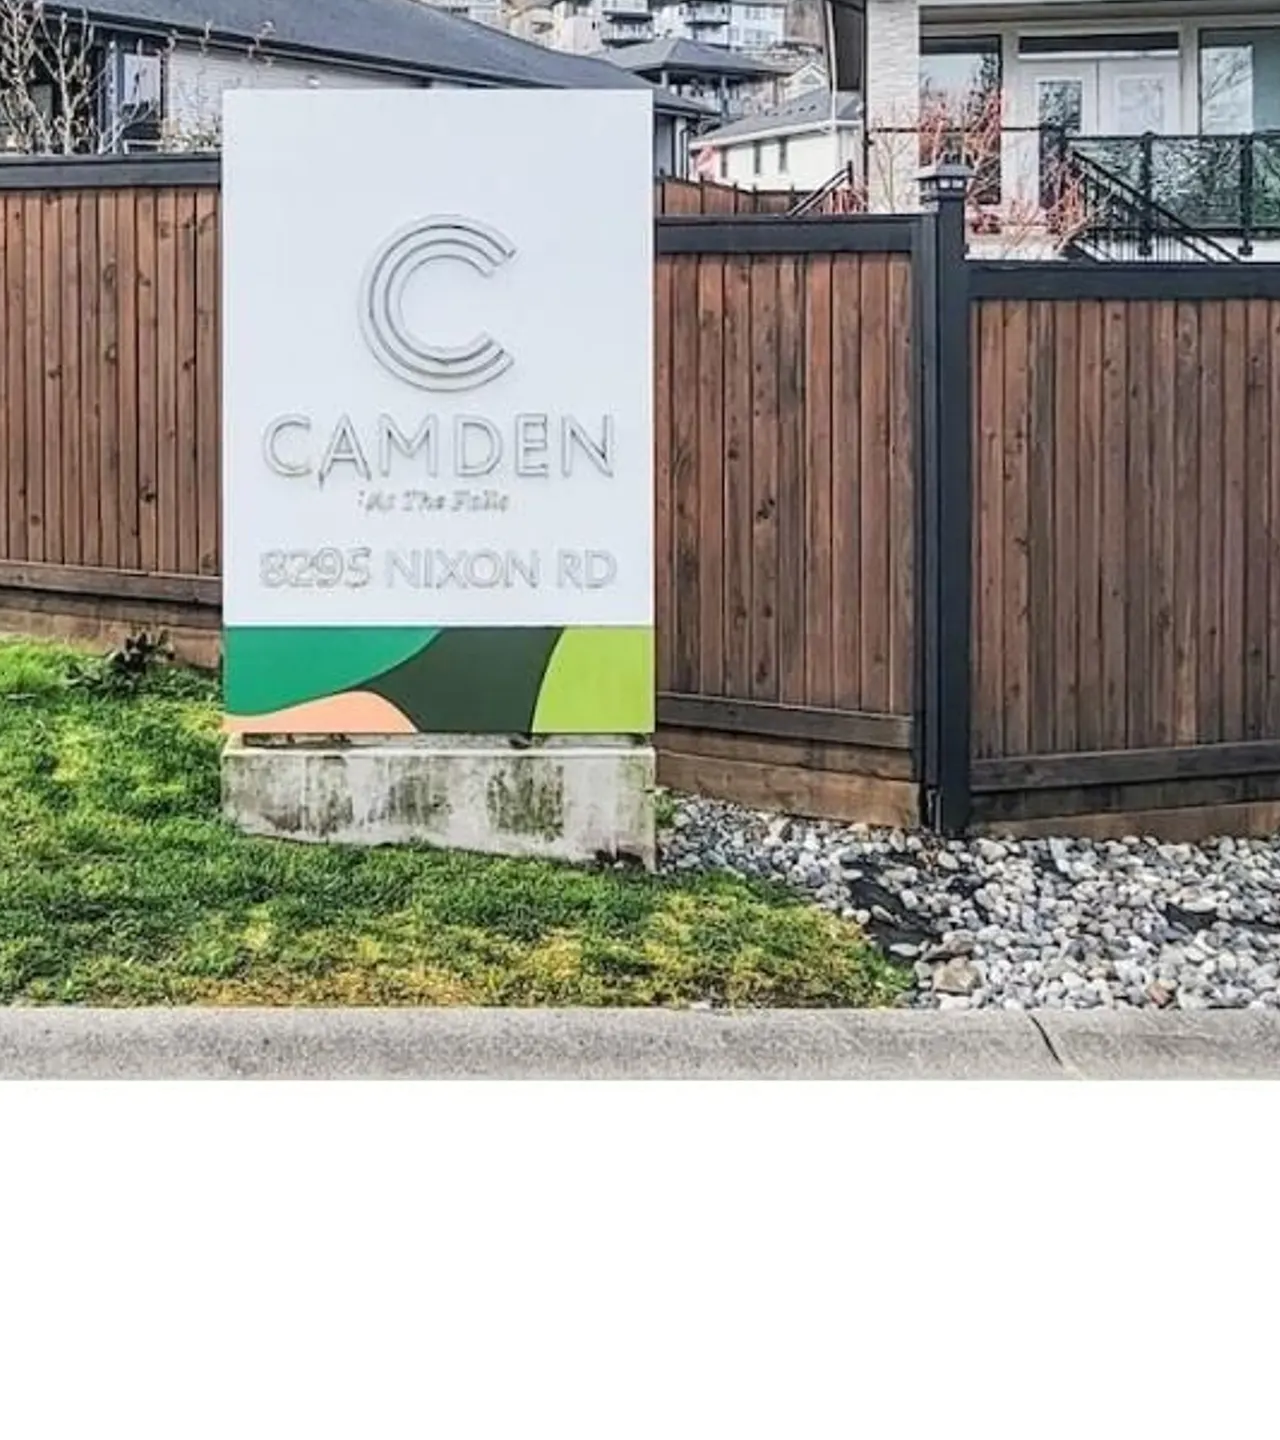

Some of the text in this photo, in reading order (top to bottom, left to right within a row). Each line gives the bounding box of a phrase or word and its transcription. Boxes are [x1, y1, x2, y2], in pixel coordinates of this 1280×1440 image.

[357, 213, 516, 392] C
[262, 412, 614, 481] CAMDEN
[402, 489, 446, 511] The
[259, 546, 618, 589] 8295 NIXON RD
